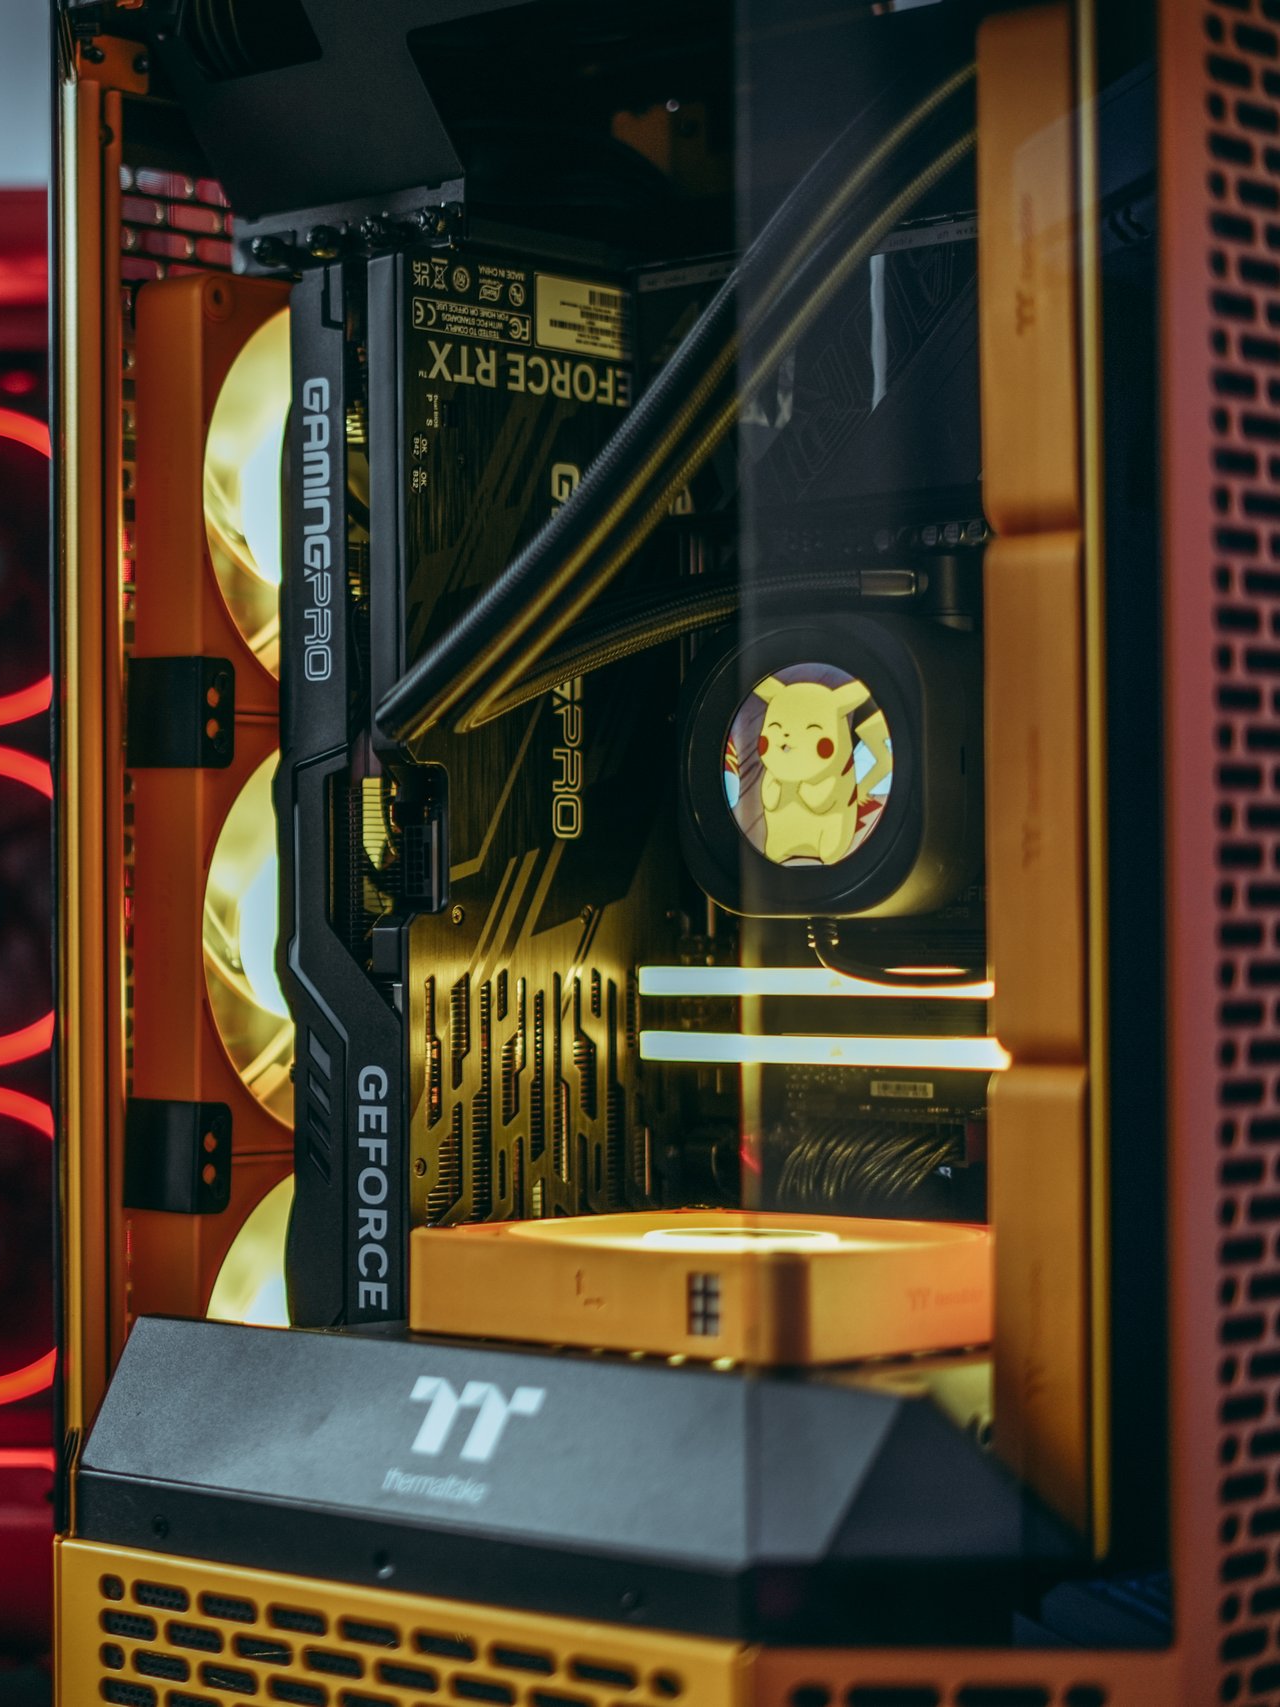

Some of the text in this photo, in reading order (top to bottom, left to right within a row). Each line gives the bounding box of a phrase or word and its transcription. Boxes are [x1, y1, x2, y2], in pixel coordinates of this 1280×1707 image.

[478, 265, 526, 282] MADE IN CHINA
[435, 302, 509, 321] FOR HOME OR OFFICE USE
[442, 313, 476, 325] STANDARDS
[445, 324, 500, 340] TESTED TO COMPLY
[488, 320, 504, 330] WITH
[421, 438, 428, 453] OK
[421, 471, 428, 487] OK
[356, 1063, 390, 1312] GEFORCE
[381, 1466, 488, 1505] thermaltake
